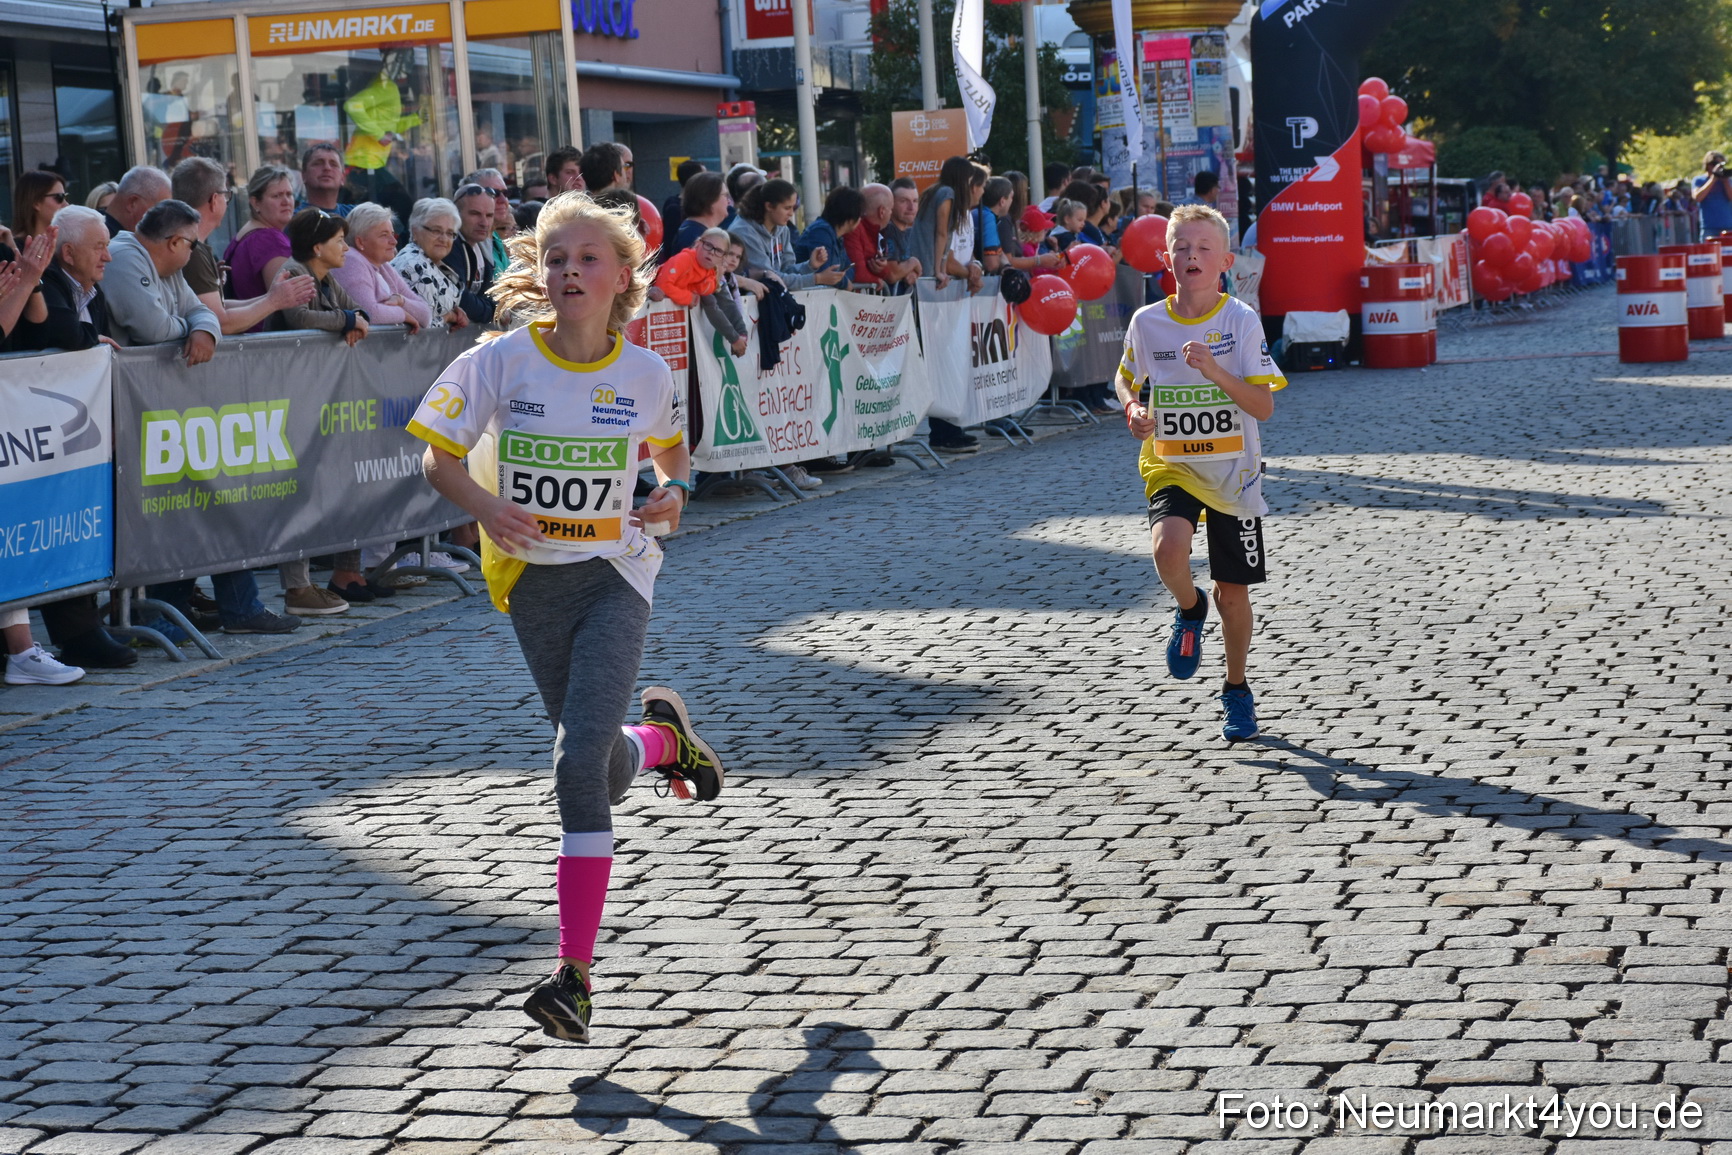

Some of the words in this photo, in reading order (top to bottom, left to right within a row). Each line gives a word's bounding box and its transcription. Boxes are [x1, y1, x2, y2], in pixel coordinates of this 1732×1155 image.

[1283, 0, 1327, 28] PAR
[269, 13, 435, 43] RUNMARKT.DE
[1270, 175, 1281, 183] 100
[1281, 174, 1304, 182] YEARS
[1279, 167, 1292, 175] THE
[1293, 166, 1313, 175] NEXT
[1271, 202, 1295, 212] BMW
[1296, 201, 1343, 212] Laufsport
[1272, 234, 1344, 244] www.bmw-partl.de
[1206, 332, 1221, 344] 20
[427, 387, 465, 420] 20
[594, 389, 616, 404] 20
[617, 397, 634, 406] JAHRE
[1160, 389, 1230, 404] BOCK
[510, 401, 543, 412] BOCK
[592, 405, 639, 419] Neumarkter
[319, 399, 377, 437] OFFICE
[591, 416, 631, 427] Stadtlauf
[1163, 409, 1233, 436] 5008
[145, 408, 292, 476] BOCK
[511, 438, 612, 464] BOCK
[1183, 442, 1215, 454] LUIS
[141, 490, 191, 518] inspired
[193, 487, 212, 512] by
[214, 487, 249, 506] smart
[250, 477, 299, 501] concepts
[511, 470, 612, 512] 5007
[29, 506, 102, 554] ZUHAUSE
[537, 519, 597, 538] OPHIA
